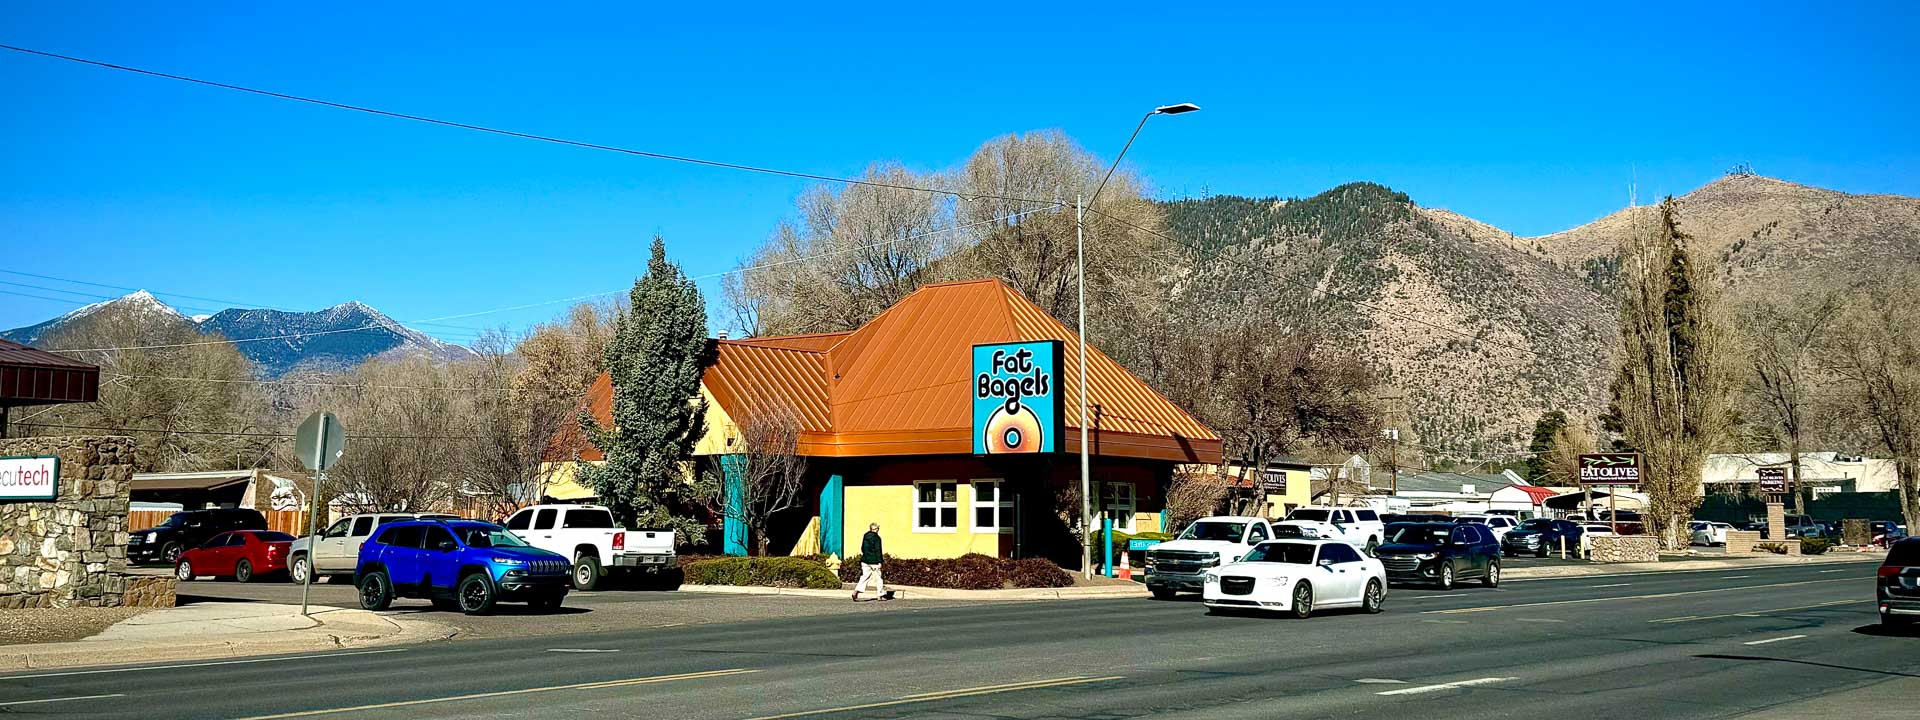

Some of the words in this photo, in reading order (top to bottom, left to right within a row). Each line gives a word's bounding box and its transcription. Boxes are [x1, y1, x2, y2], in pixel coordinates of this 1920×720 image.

[992, 348, 1032, 375] Fat
[977, 366, 1049, 415] Bagels
[0, 464, 49, 486] cutech
[1580, 467, 1600, 477] FAT
[1600, 467, 1639, 477] OLIVES
